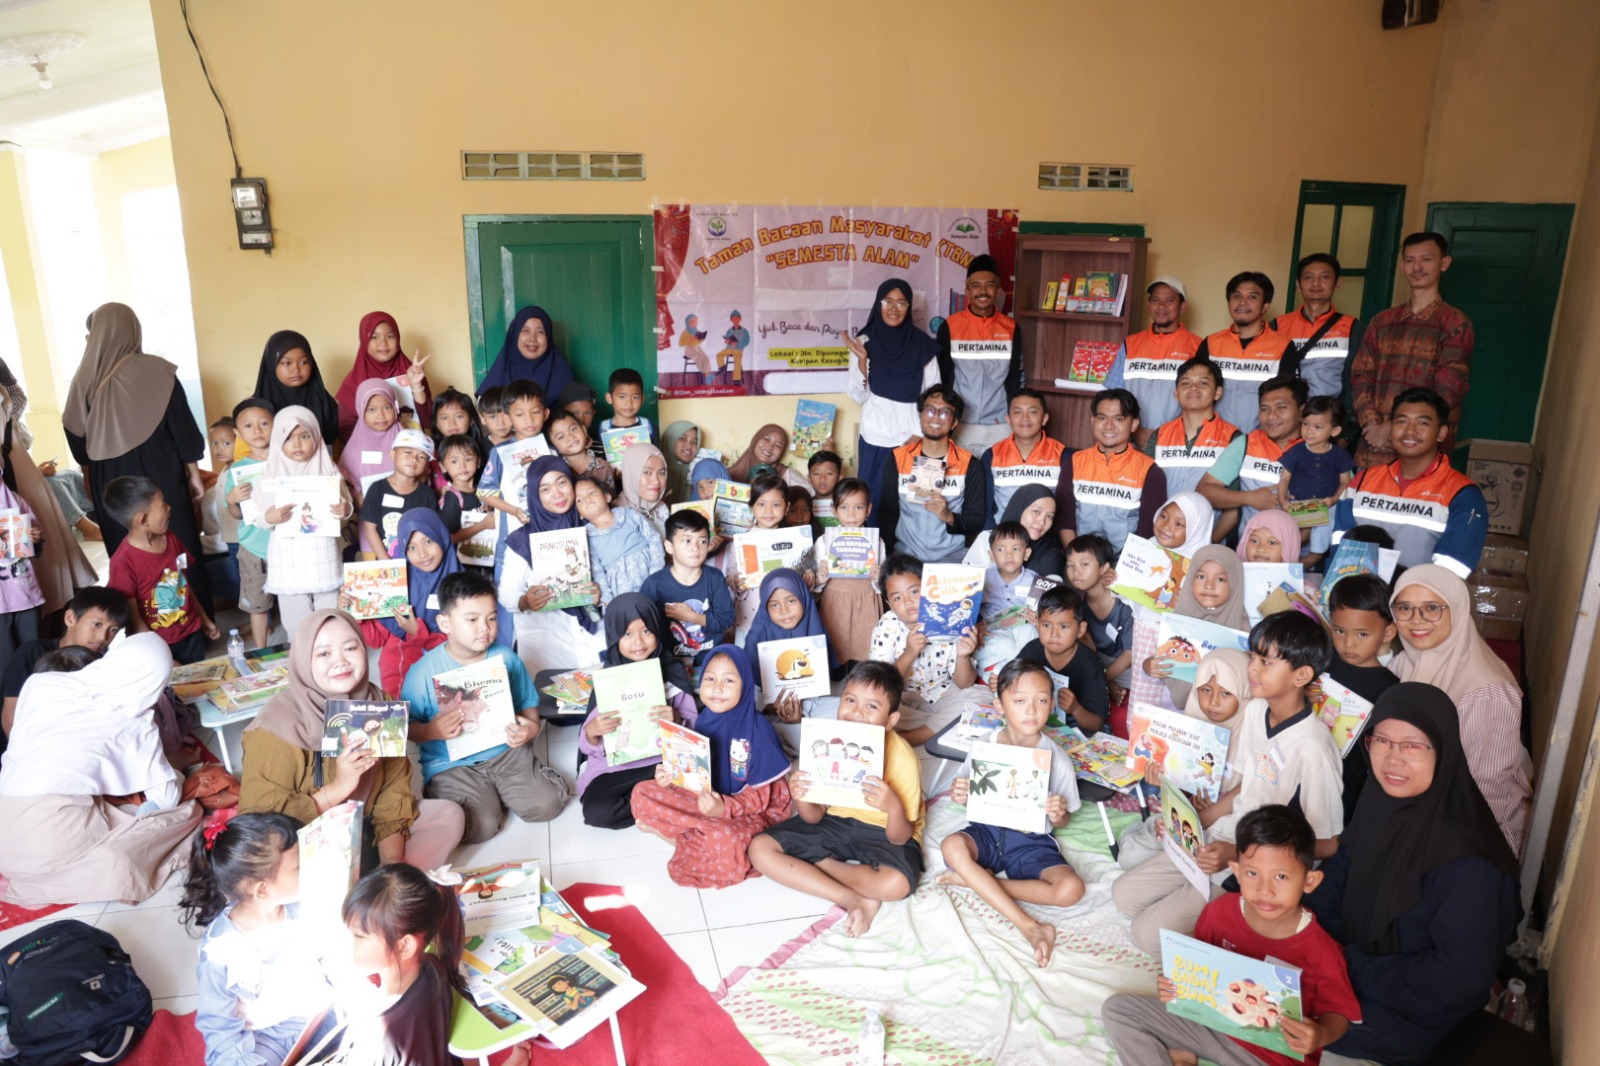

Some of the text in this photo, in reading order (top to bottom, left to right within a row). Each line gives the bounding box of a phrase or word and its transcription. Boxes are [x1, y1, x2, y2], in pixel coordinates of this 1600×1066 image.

[694, 237, 754, 275] Taman
[757, 220, 823, 246] Bacaan
[830, 216, 932, 249] Masyarakat
[766, 243, 920, 270] "SEMESTA ALAM"
[779, 320, 802, 334] Baca
[804, 321, 820, 333] dan
[958, 343, 1008, 351] PERTAMINA
[1128, 361, 1179, 371] PERTAMIN
[1161, 449, 1216, 459] PERTAMINA
[996, 468, 1052, 478] PERTAMINA
[1077, 484, 1132, 500] PERTAMINA
[1361, 496, 1433, 517] PERTAMINA
[540, 539, 579, 551] PANGSUMA
[925, 573, 982, 588] Astronaut
[927, 585, 959, 599] Cilik
[464, 678, 503, 689] Bhema
[621, 691, 645, 702] Bosu
